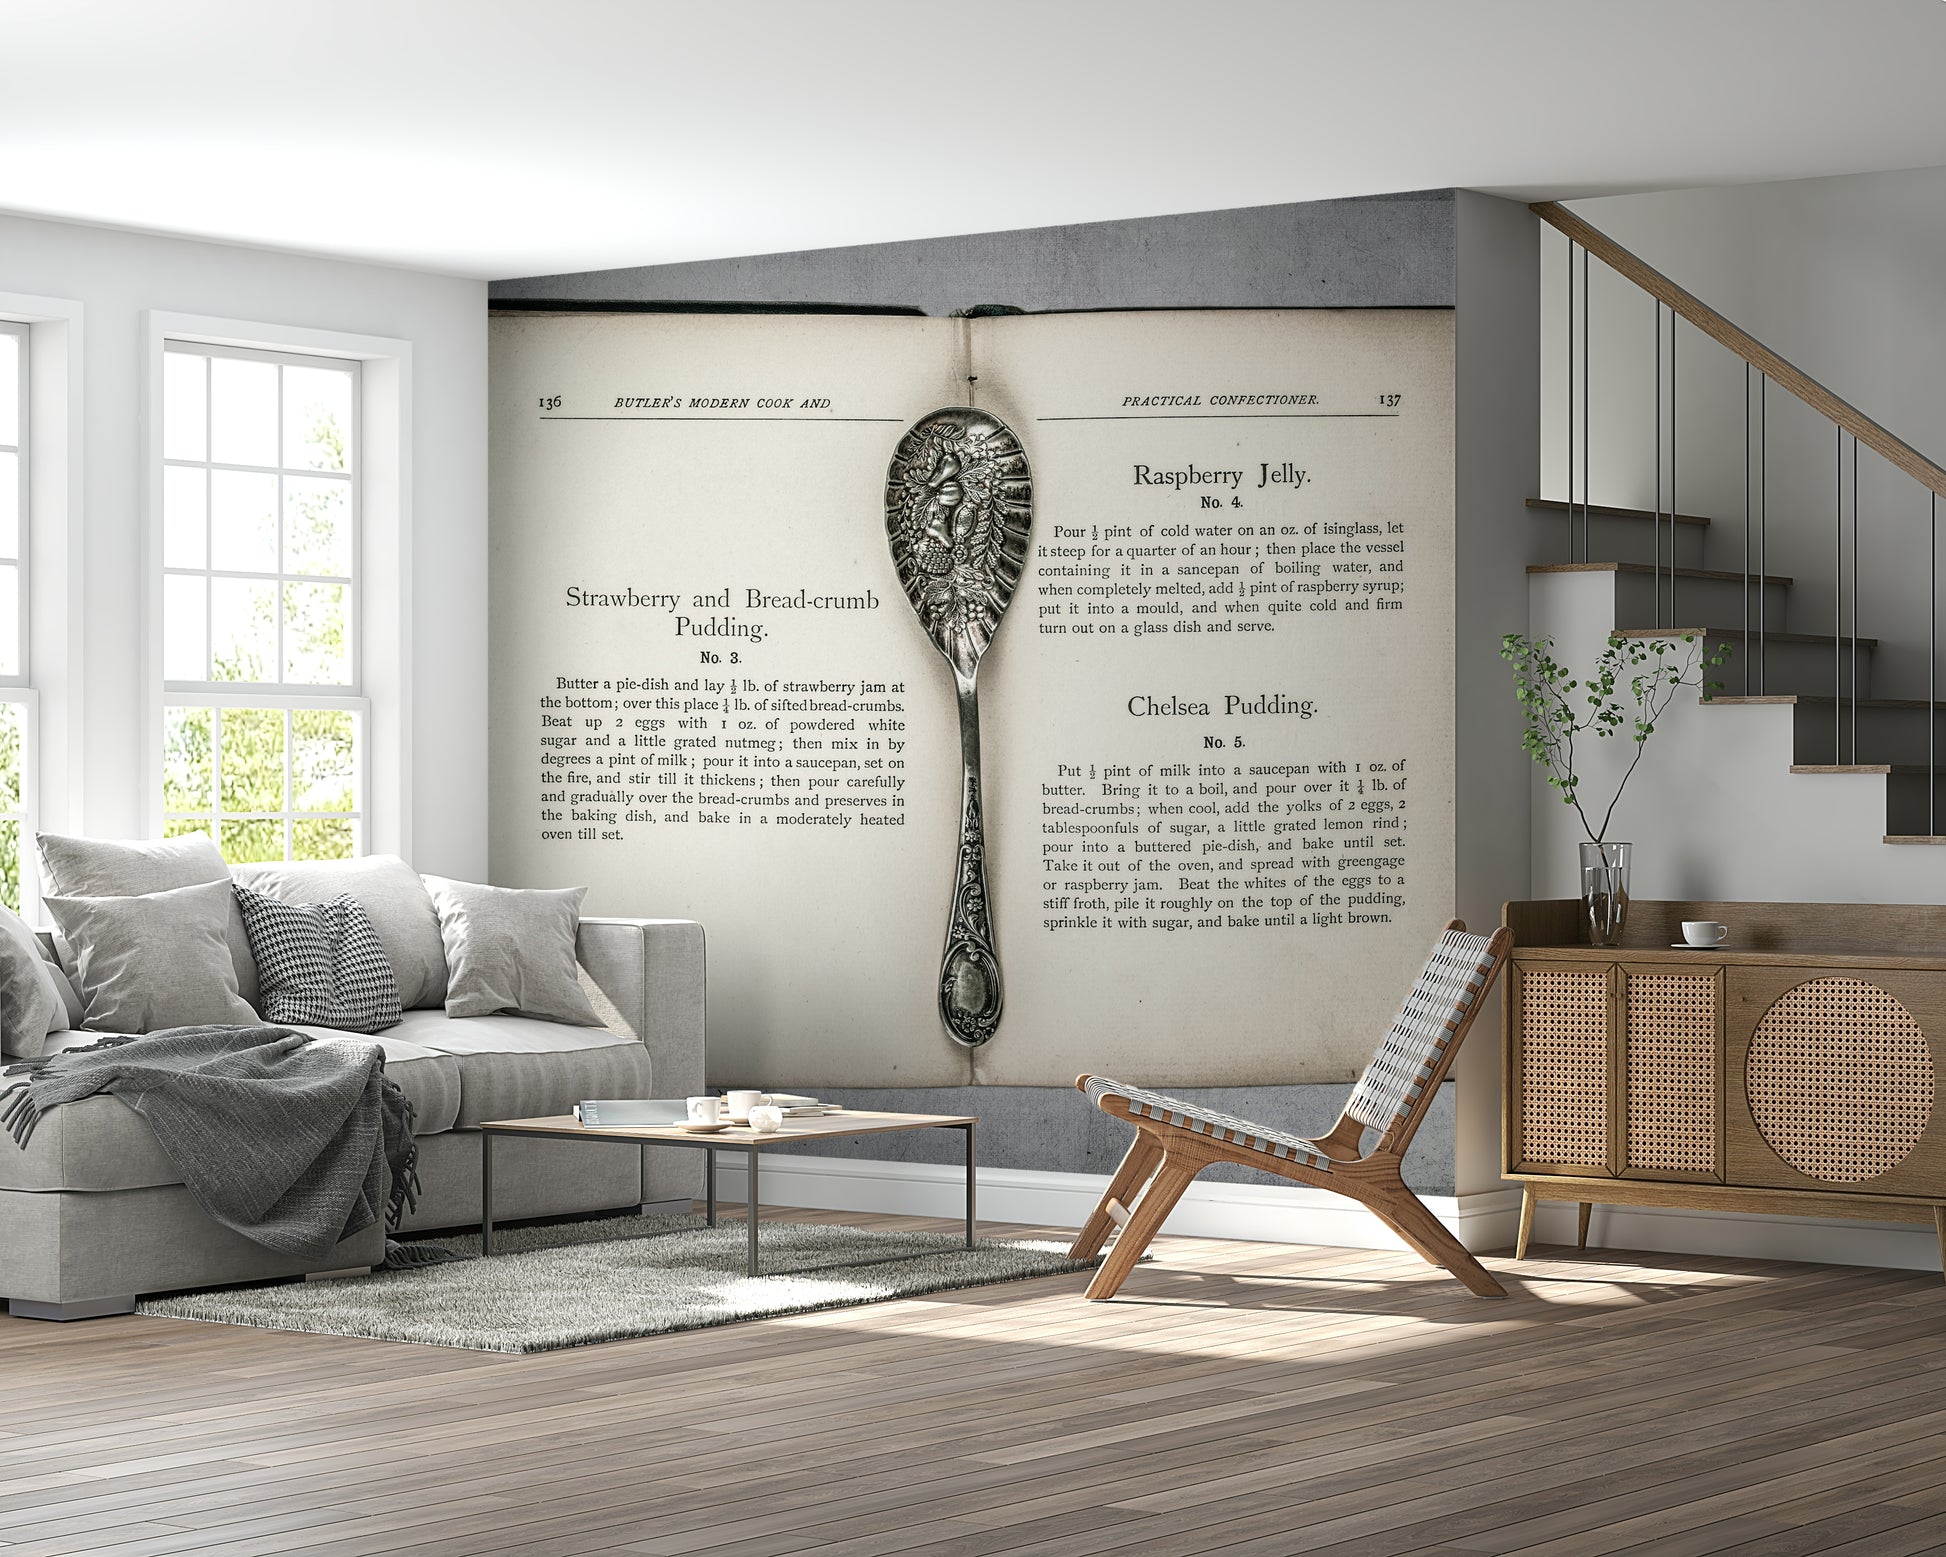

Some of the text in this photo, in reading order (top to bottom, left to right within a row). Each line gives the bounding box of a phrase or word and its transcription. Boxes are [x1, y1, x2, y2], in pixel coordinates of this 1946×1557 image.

[538, 394, 832, 411] 136 BUTLER'S MODERN COOK AND
[1121, 393, 1402, 408] PRACTICAL CONFECTIONER. 137
[1133, 462, 1311, 491] Raspberry Jelly.
[1200, 495, 1244, 509] No. 4.
[1053, 520, 1405, 541] Pour pint cold water isinglass, let
[1050, 540, 1405, 561] steep for quarter then place vessel
[1038, 563, 1111, 580] containing
[1274, 560, 1322, 577] boiling
[1331, 561, 1372, 575] water,
[1379, 559, 1404, 572] and
[1037, 579, 1404, 599] when completely melted, pint raspberry syrup;
[566, 586, 880, 614] Strawberry and Bread-crumb
[1087, 597, 1403, 616] into mould, when quite cold firm
[674, 616, 769, 644] Pudding.
[1038, 619, 1275, 638] turn out glass dish and serve.
[699, 650, 743, 665] No. 3.
[555, 676, 856, 697] Butter pie-dish and lay strawberry
[564, 695, 905, 714] bottom; over this place sifted bread-crumbs.
[1127, 693, 1318, 720] Chelsea Pudding.
[541, 714, 906, 734] Beat eggs with powdered white
[540, 733, 823, 751] sugar and little grated then
[1203, 735, 1246, 749] No. 5.
[540, 752, 861, 772] degrees pint pour into saucepan,
[1103, 760, 1347, 781] pint milk into saucepan with
[567, 770, 906, 792] fire, stir till then pour carefully
[1041, 781, 1333, 800] butter. Bring boil, pour over
[540, 789, 888, 810] and gradually over bread-crumbs preserves
[1041, 799, 1394, 818] bread-crumbs; when cool, yolks eggs,
[571, 808, 905, 829] baking dish, bake moderately heated
[1041, 817, 1364, 838] tablespoonfuls sugar, little grated lemon
[541, 827, 624, 841] oven till set.
[1042, 835, 1374, 856] pour into buttered pie-dish, bake until
[1042, 855, 1406, 874] Take oven, spread with greengage
[1064, 876, 1372, 894] raspberry jam. Beat whites eggs
[1042, 891, 1406, 913] stiff froth, pile roughly pudding,
[1043, 911, 1392, 932] sprinkle with sugar, bake until light brown.
